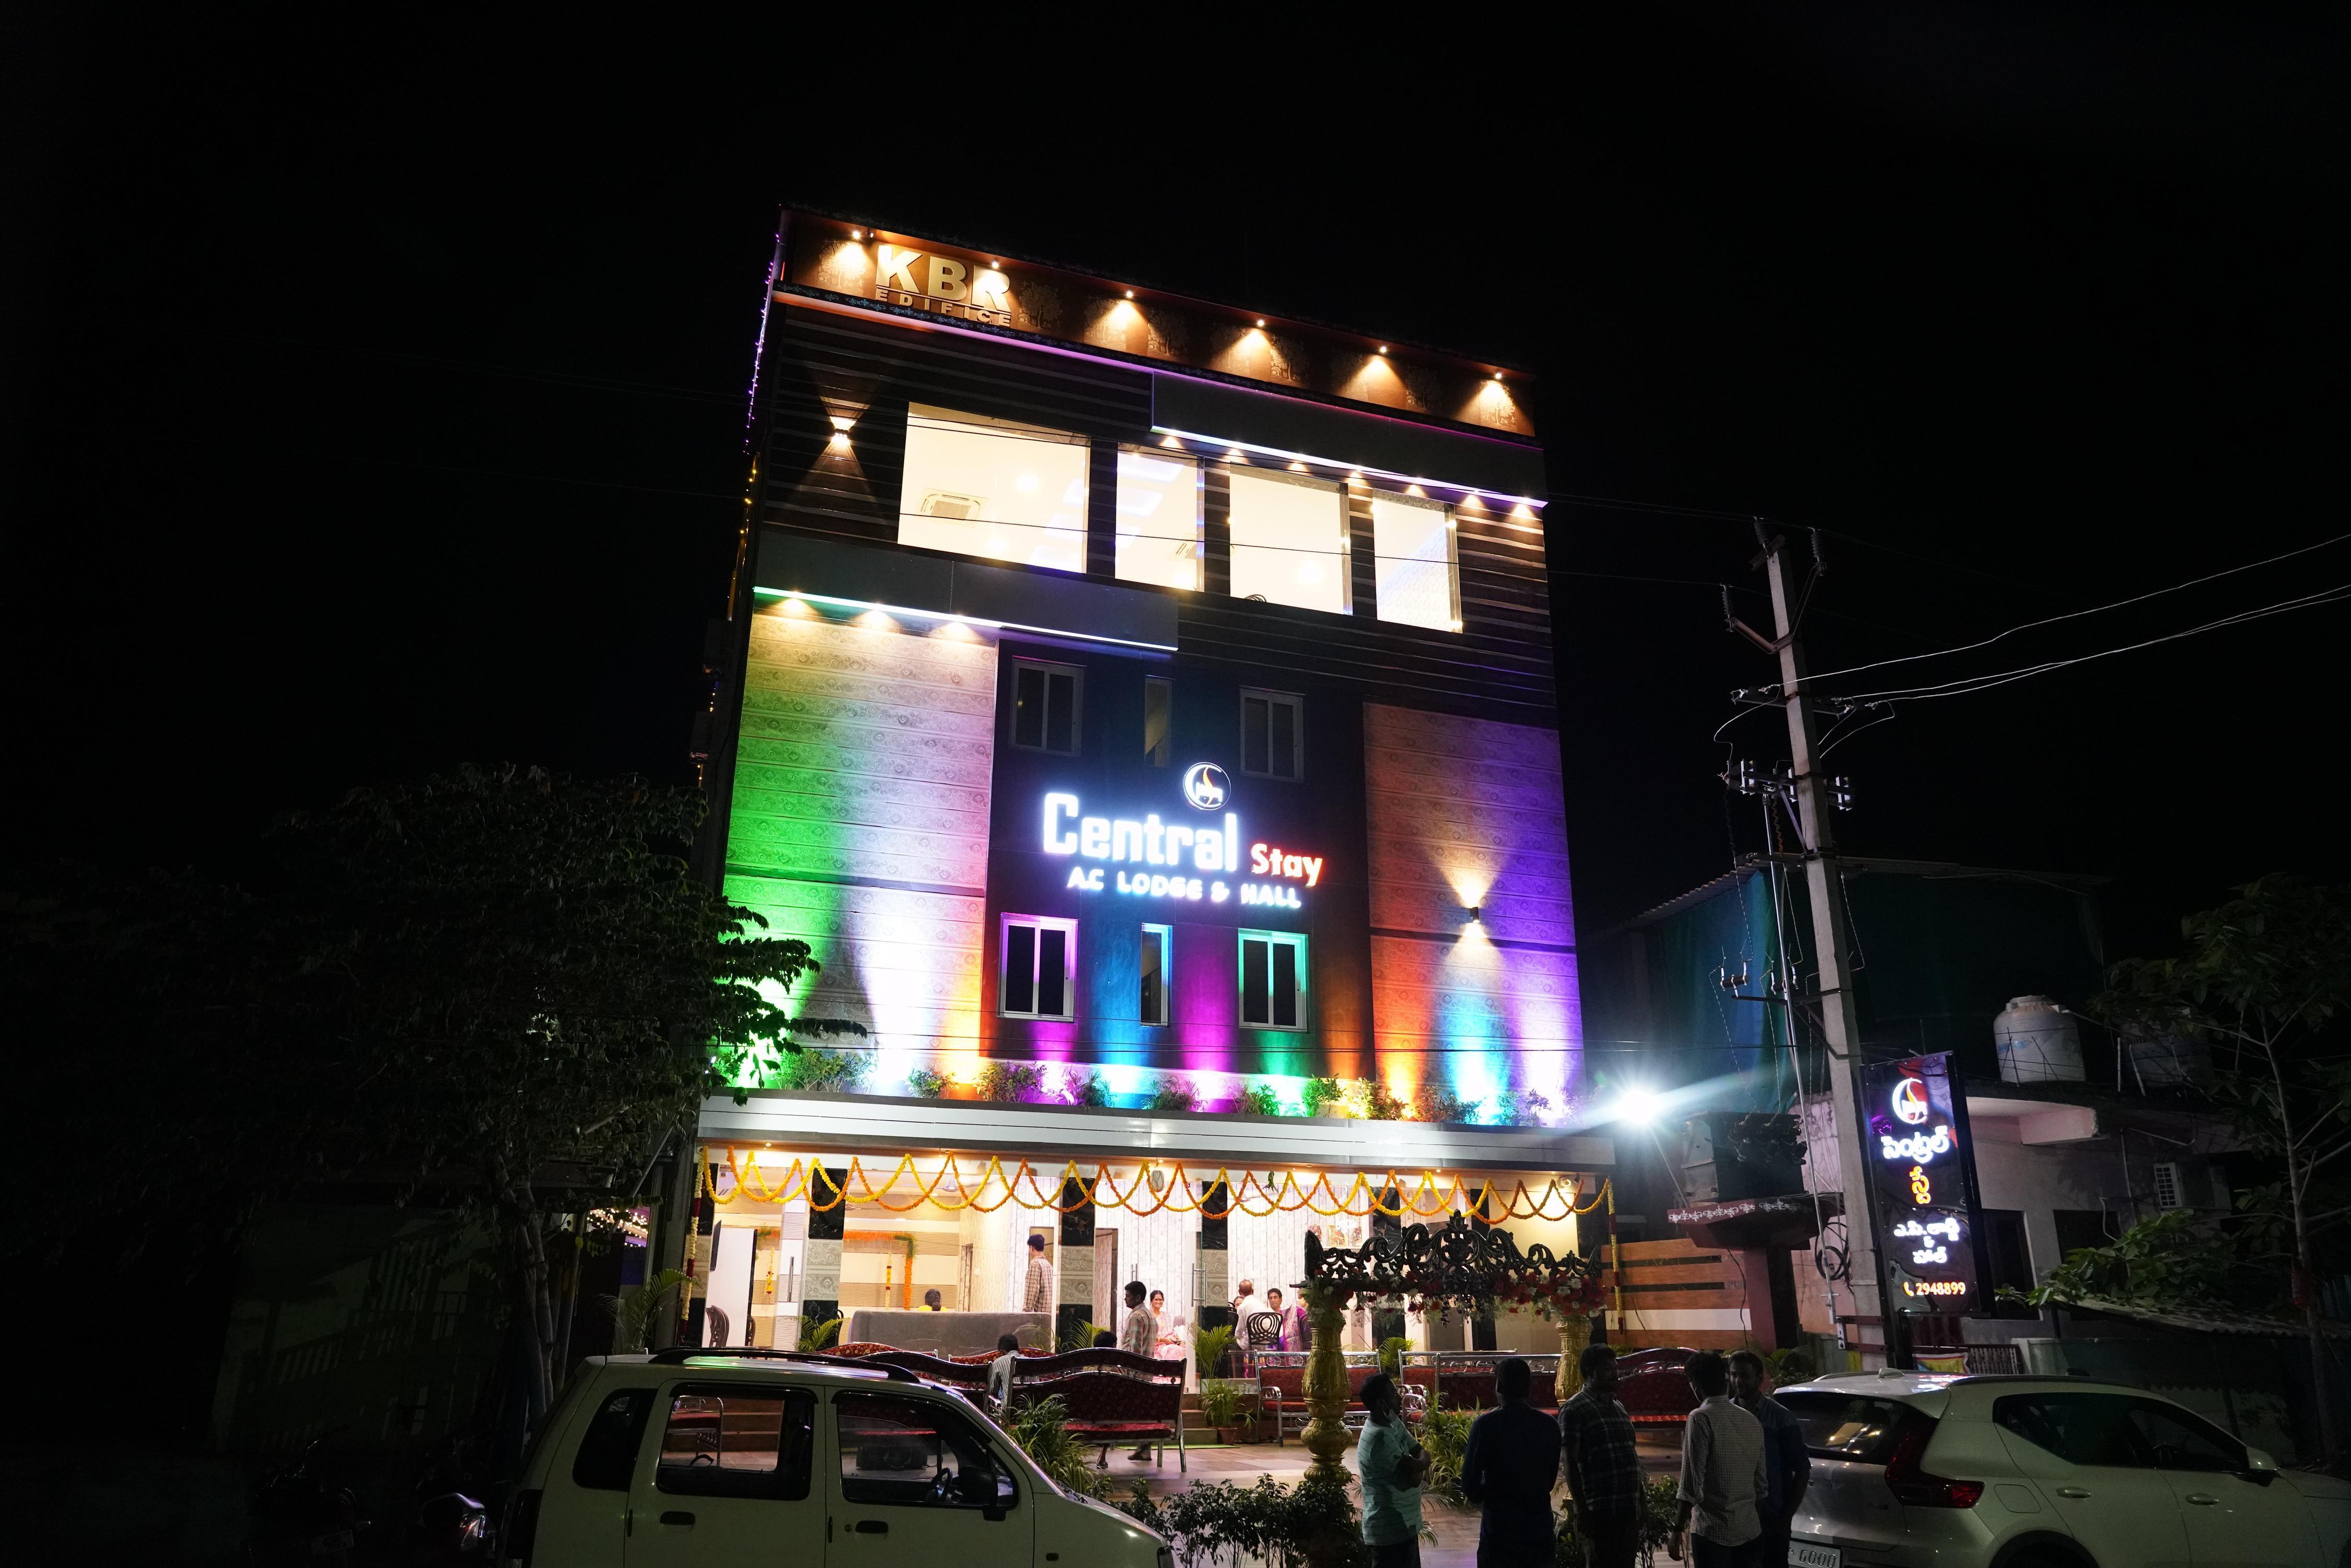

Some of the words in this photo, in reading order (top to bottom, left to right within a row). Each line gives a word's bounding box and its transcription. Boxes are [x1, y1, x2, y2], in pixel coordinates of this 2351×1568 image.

[876, 245, 1011, 312] KBR
[876, 288, 1011, 327] EDIFICE
[1043, 793, 1237, 872] Central
[1251, 843, 1323, 887] Stay
[1117, 871, 1203, 899] LODGE
[1211, 881, 1230, 901] &
[1241, 884, 1301, 908] HALL
[1881, 1125, 1949, 1164] సెంట్రల్
[1915, 1282, 1966, 1295] 2948899
[1799, 1549, 1836, 1568] 6000
